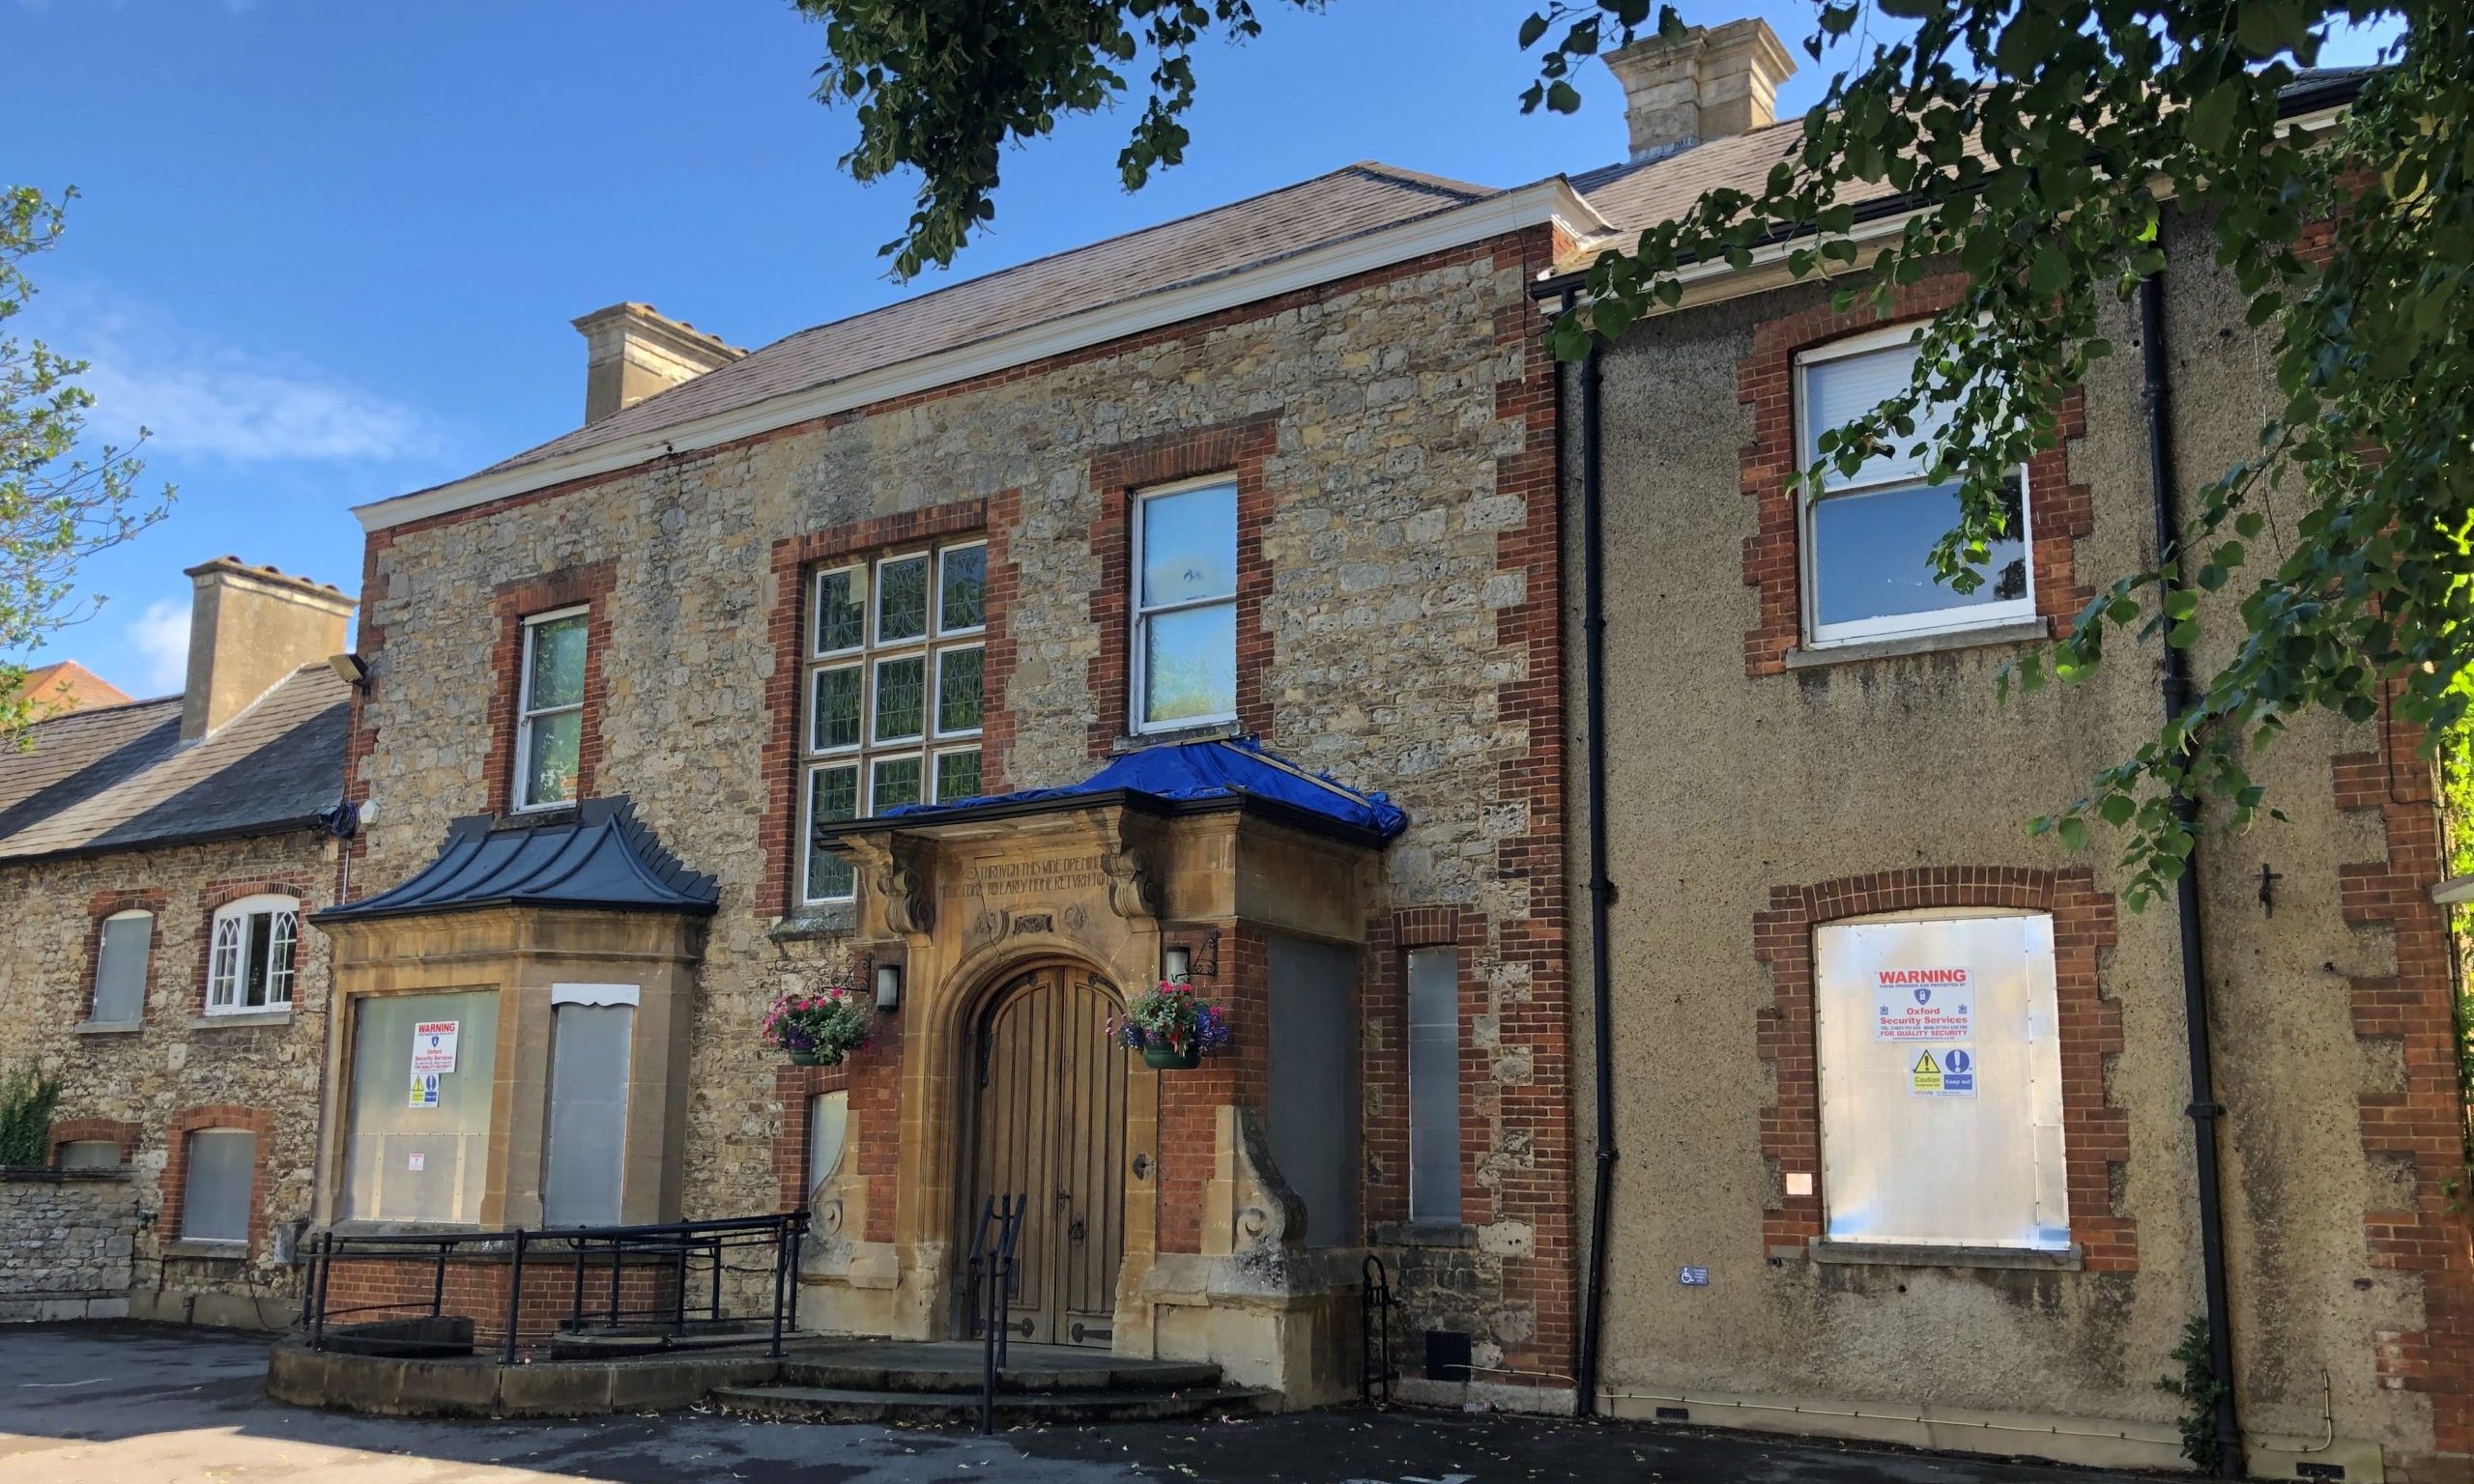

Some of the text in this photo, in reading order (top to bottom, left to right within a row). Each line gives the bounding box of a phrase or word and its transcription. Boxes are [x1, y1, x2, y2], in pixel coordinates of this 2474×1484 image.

[1021, 861, 1041, 876] THIS
[1043, 858, 1060, 874] WIDE
[1879, 969, 1967, 985] WARNING
[1906, 1007, 1941, 1015] Oxford
[1880, 1015, 1968, 1026] Security Services
[418, 1023, 455, 1033] WARNING
